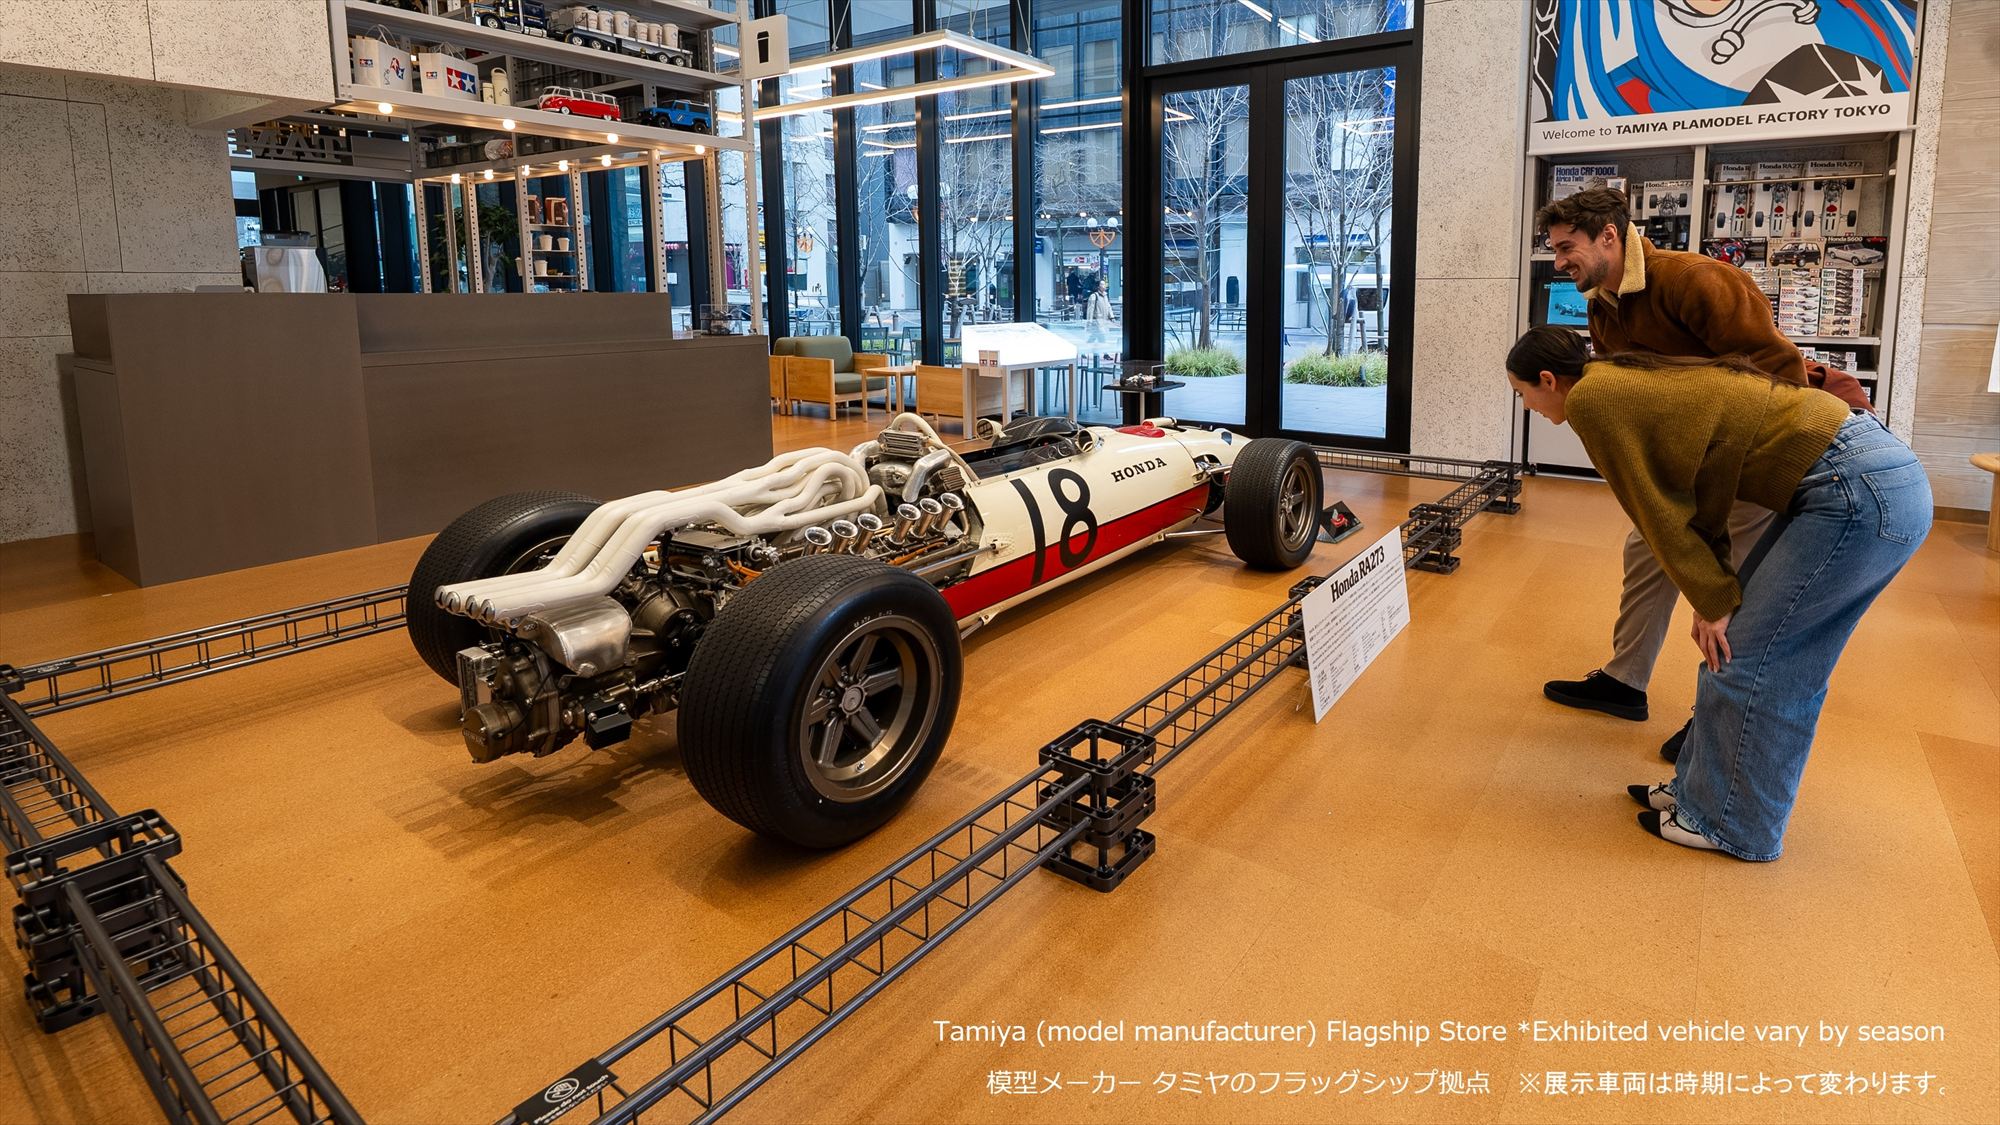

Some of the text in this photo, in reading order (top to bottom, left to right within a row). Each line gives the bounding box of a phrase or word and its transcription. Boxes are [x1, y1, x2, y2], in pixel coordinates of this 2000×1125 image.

[1542, 103, 1891, 140] Welcome to TAMIYA PLAMODEL FACTORY TOKYO
[1556, 166, 1617, 177] Honda CRF1000L
[1111, 457, 1167, 483] HONDA
[1009, 468, 1098, 588] 18
[1330, 545, 1385, 603] Honda RA273
